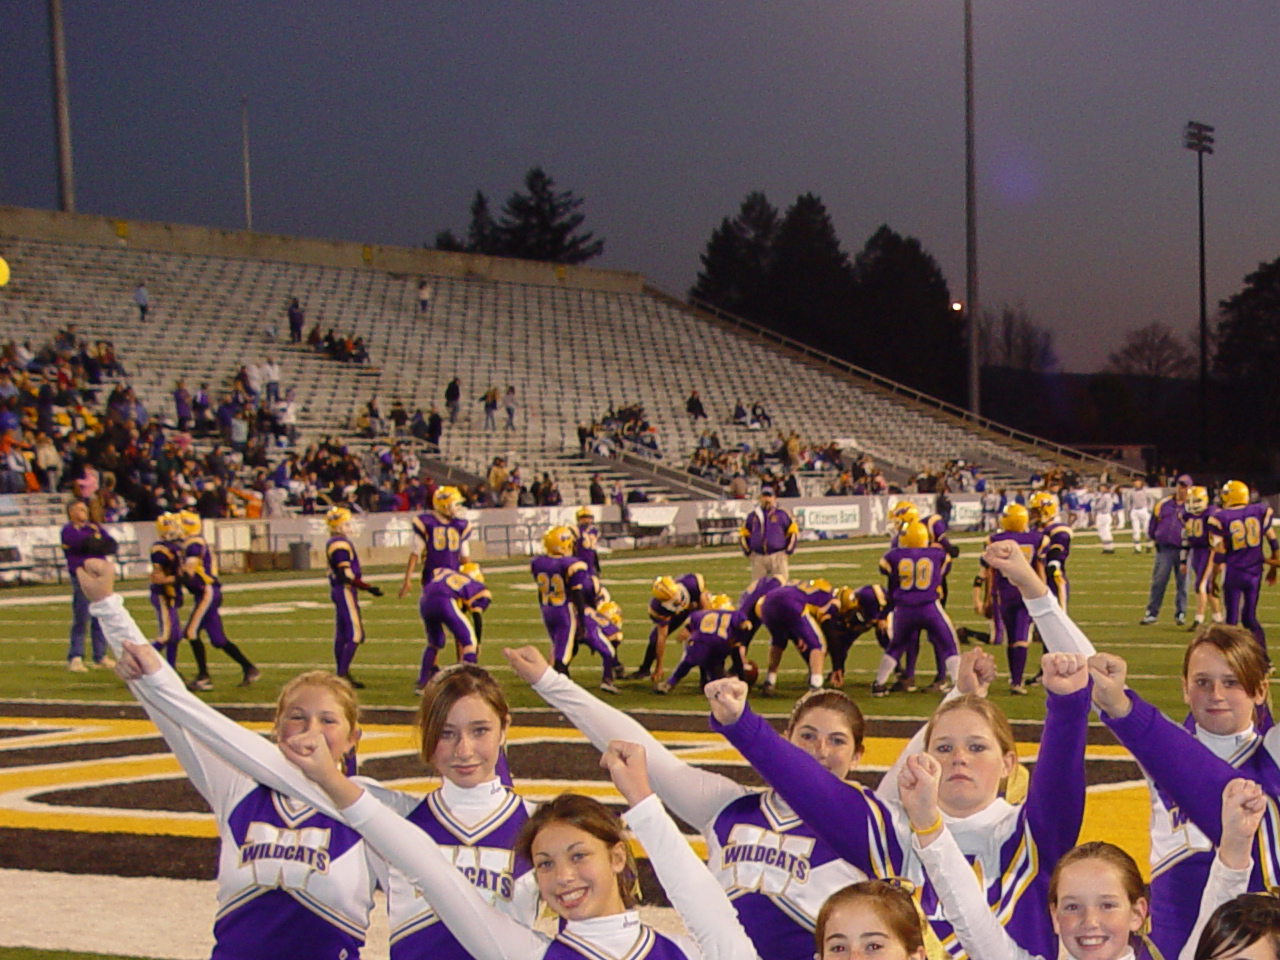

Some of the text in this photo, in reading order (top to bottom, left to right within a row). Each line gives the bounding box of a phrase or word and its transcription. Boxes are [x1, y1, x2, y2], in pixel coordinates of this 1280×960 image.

[808, 508, 858, 524] Citizens Bank
[1229, 516, 1261, 551] 20
[898, 556, 934, 591] 90
[241, 842, 328, 872] WILDCATS
[724, 844, 808, 881] WILDCATS
